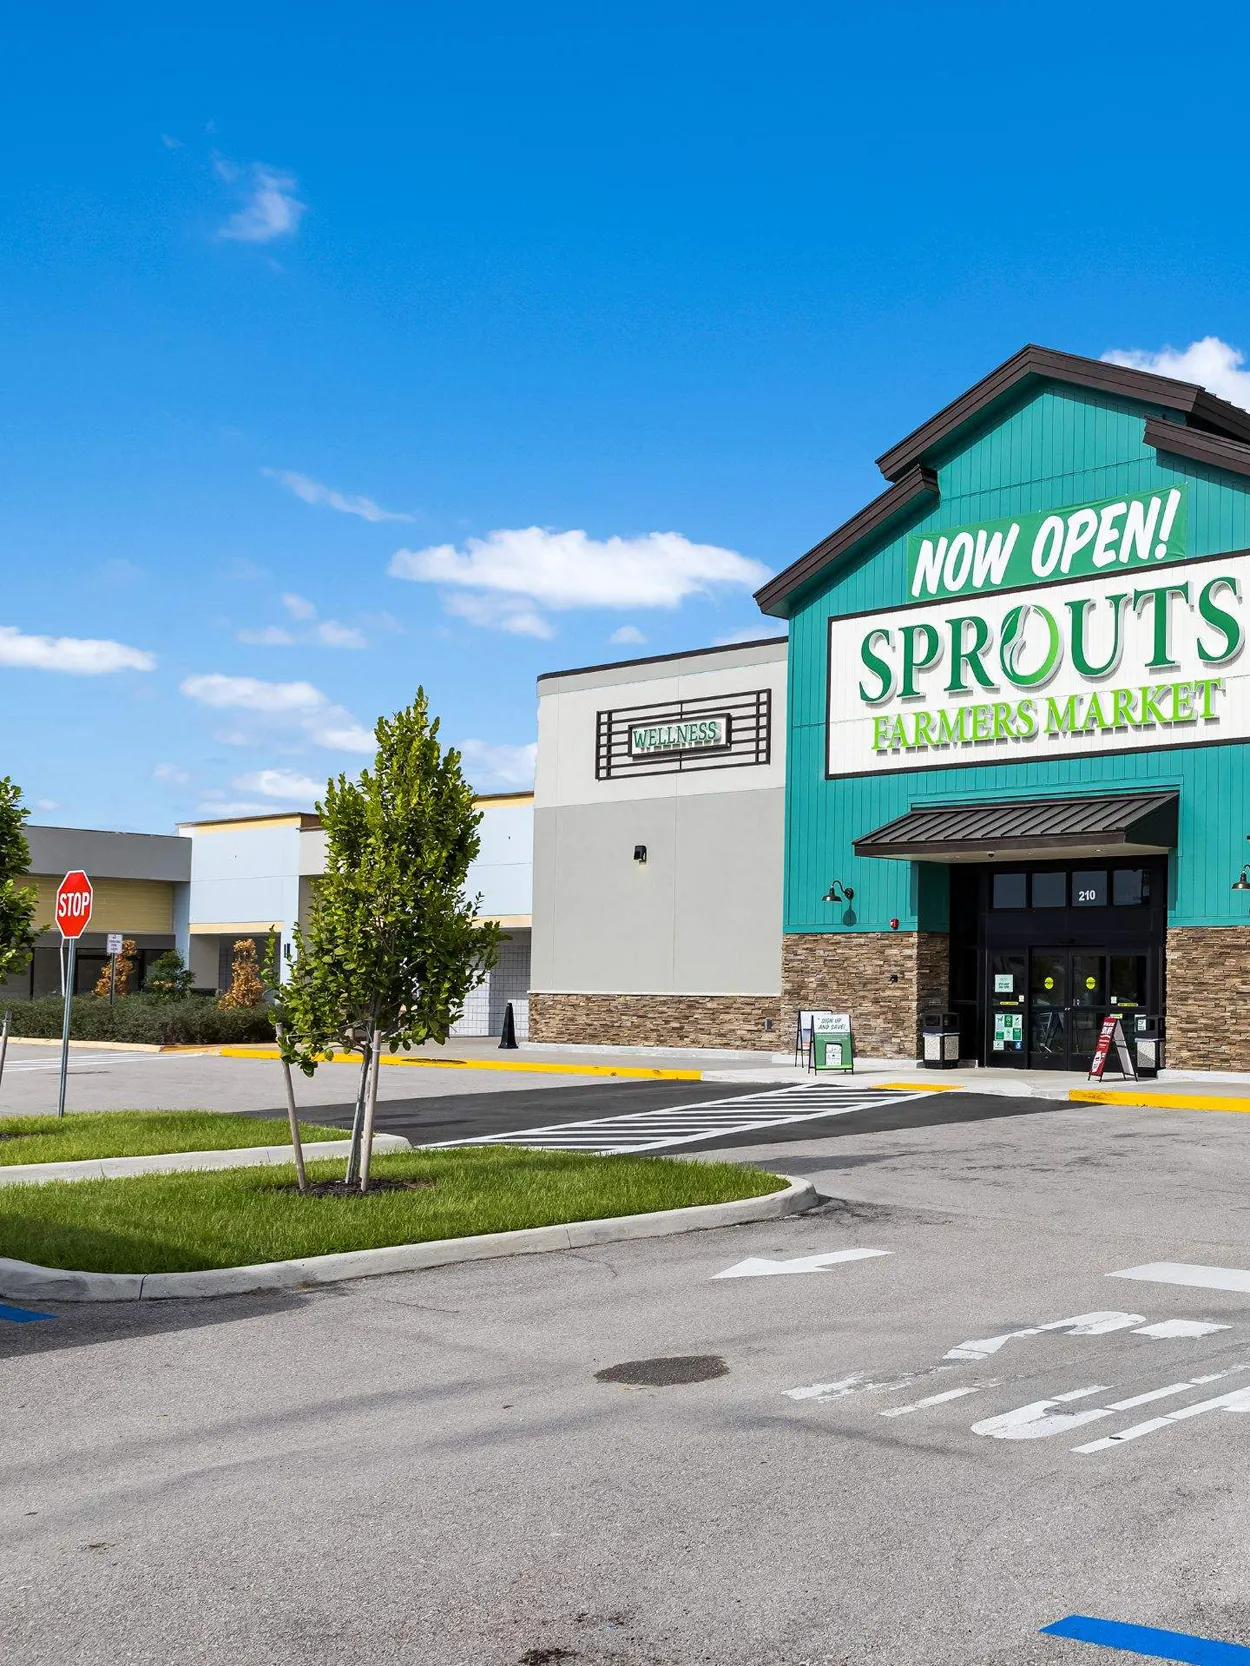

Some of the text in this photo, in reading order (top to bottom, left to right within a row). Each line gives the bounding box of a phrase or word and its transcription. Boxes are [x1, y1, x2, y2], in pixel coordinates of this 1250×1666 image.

[911, 488, 1181, 597] NOW OPEN!
[858, 576, 1241, 702] SPROUTS
[633, 721, 717, 748] WELLNESS
[871, 677, 1224, 751] FARMERS MARKET
[58, 892, 90, 917] STOP
[1078, 889, 1096, 902] 210
